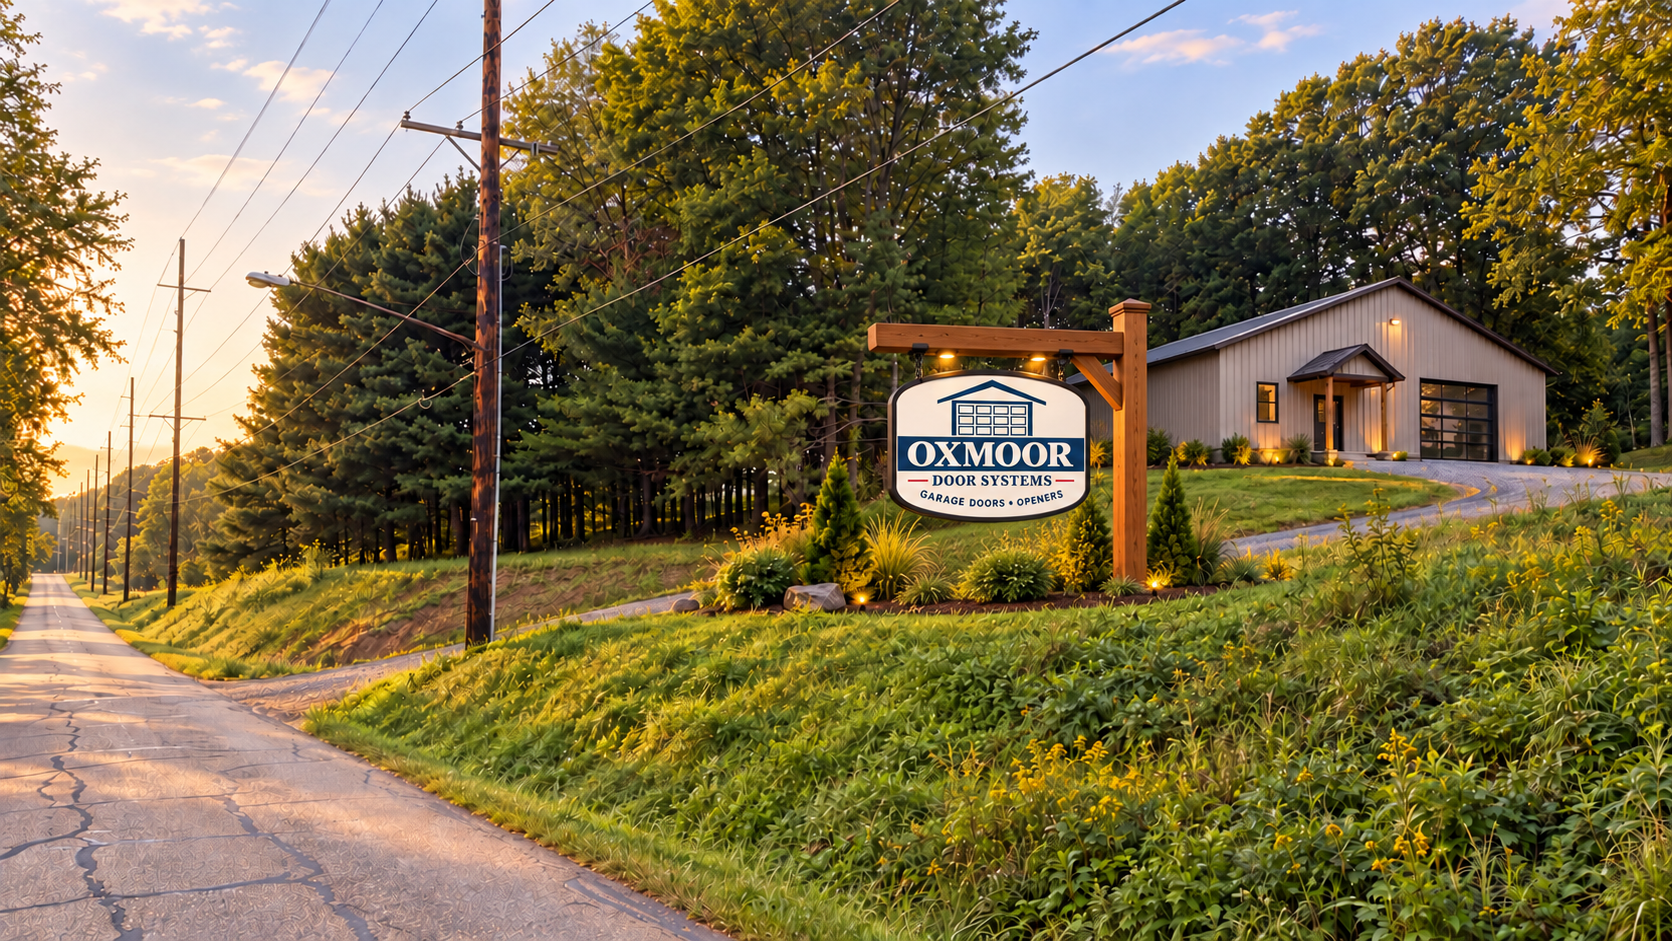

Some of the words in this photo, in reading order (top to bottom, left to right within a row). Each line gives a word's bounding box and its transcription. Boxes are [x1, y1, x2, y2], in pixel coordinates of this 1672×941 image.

[907, 440, 1074, 468] OXMOOR
[932, 475, 977, 487] DOOR
[981, 475, 1052, 487] SYSTEMS
[920, 490, 965, 506] GARAGE
[969, 499, 1005, 507] DOORS
[1017, 490, 1064, 507] OPENERS
